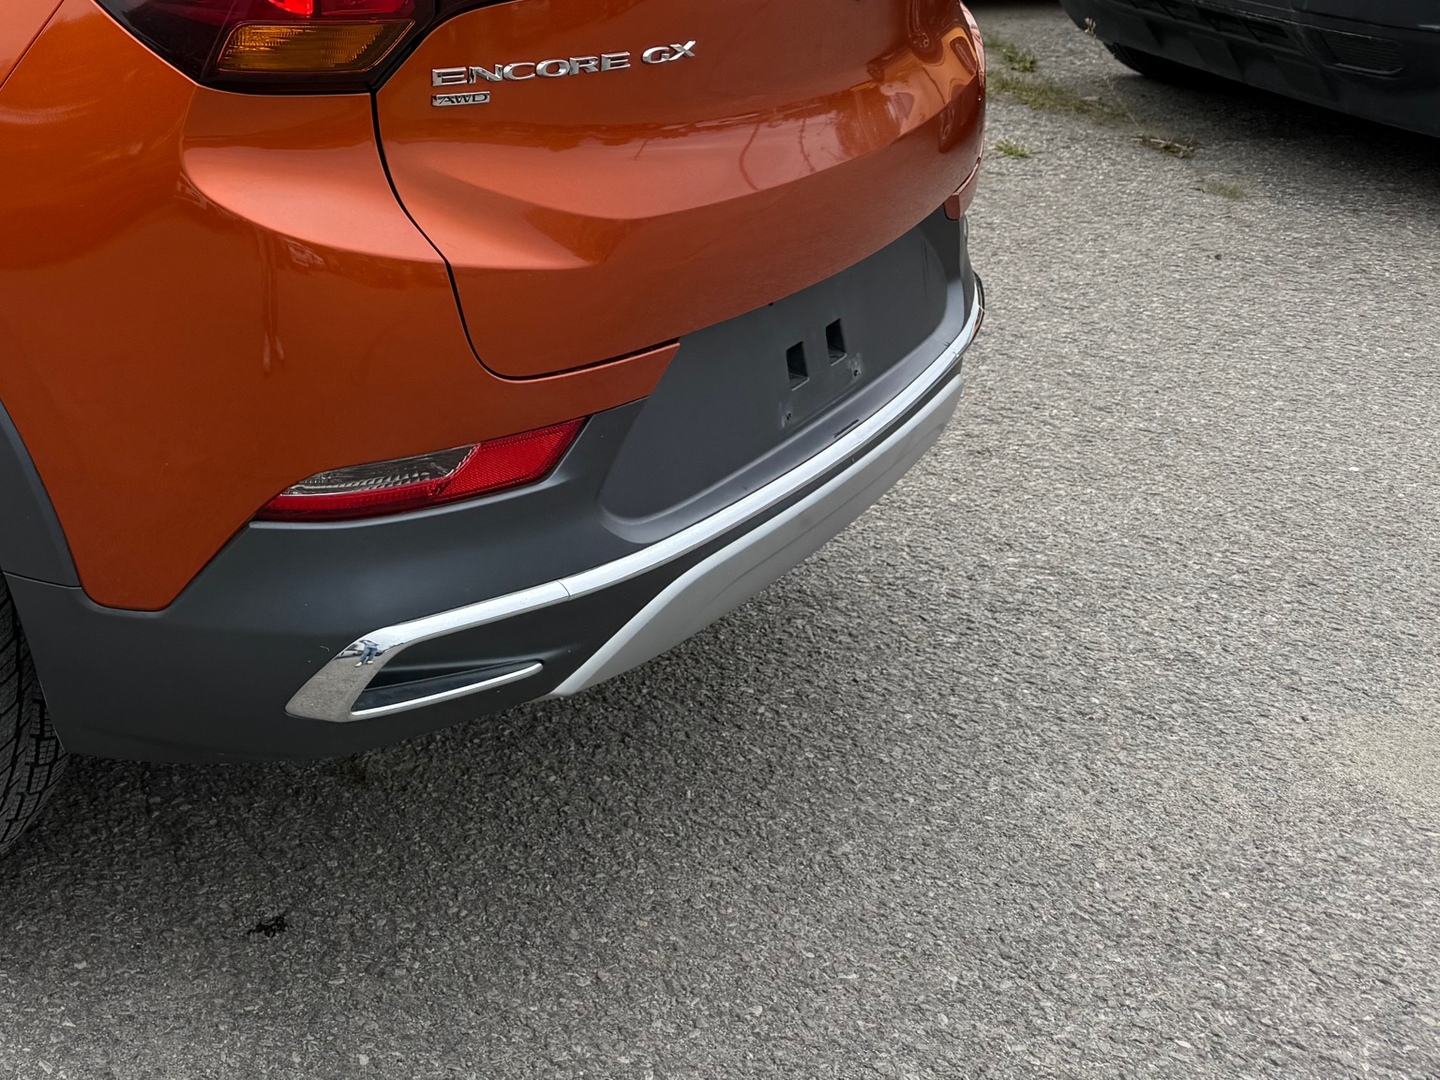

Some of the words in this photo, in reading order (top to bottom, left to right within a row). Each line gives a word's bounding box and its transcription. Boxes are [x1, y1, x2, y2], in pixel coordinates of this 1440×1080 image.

[432, 51, 631, 87] ENCORE
[642, 40, 696, 65] GX
[436, 92, 490, 105] AWD
